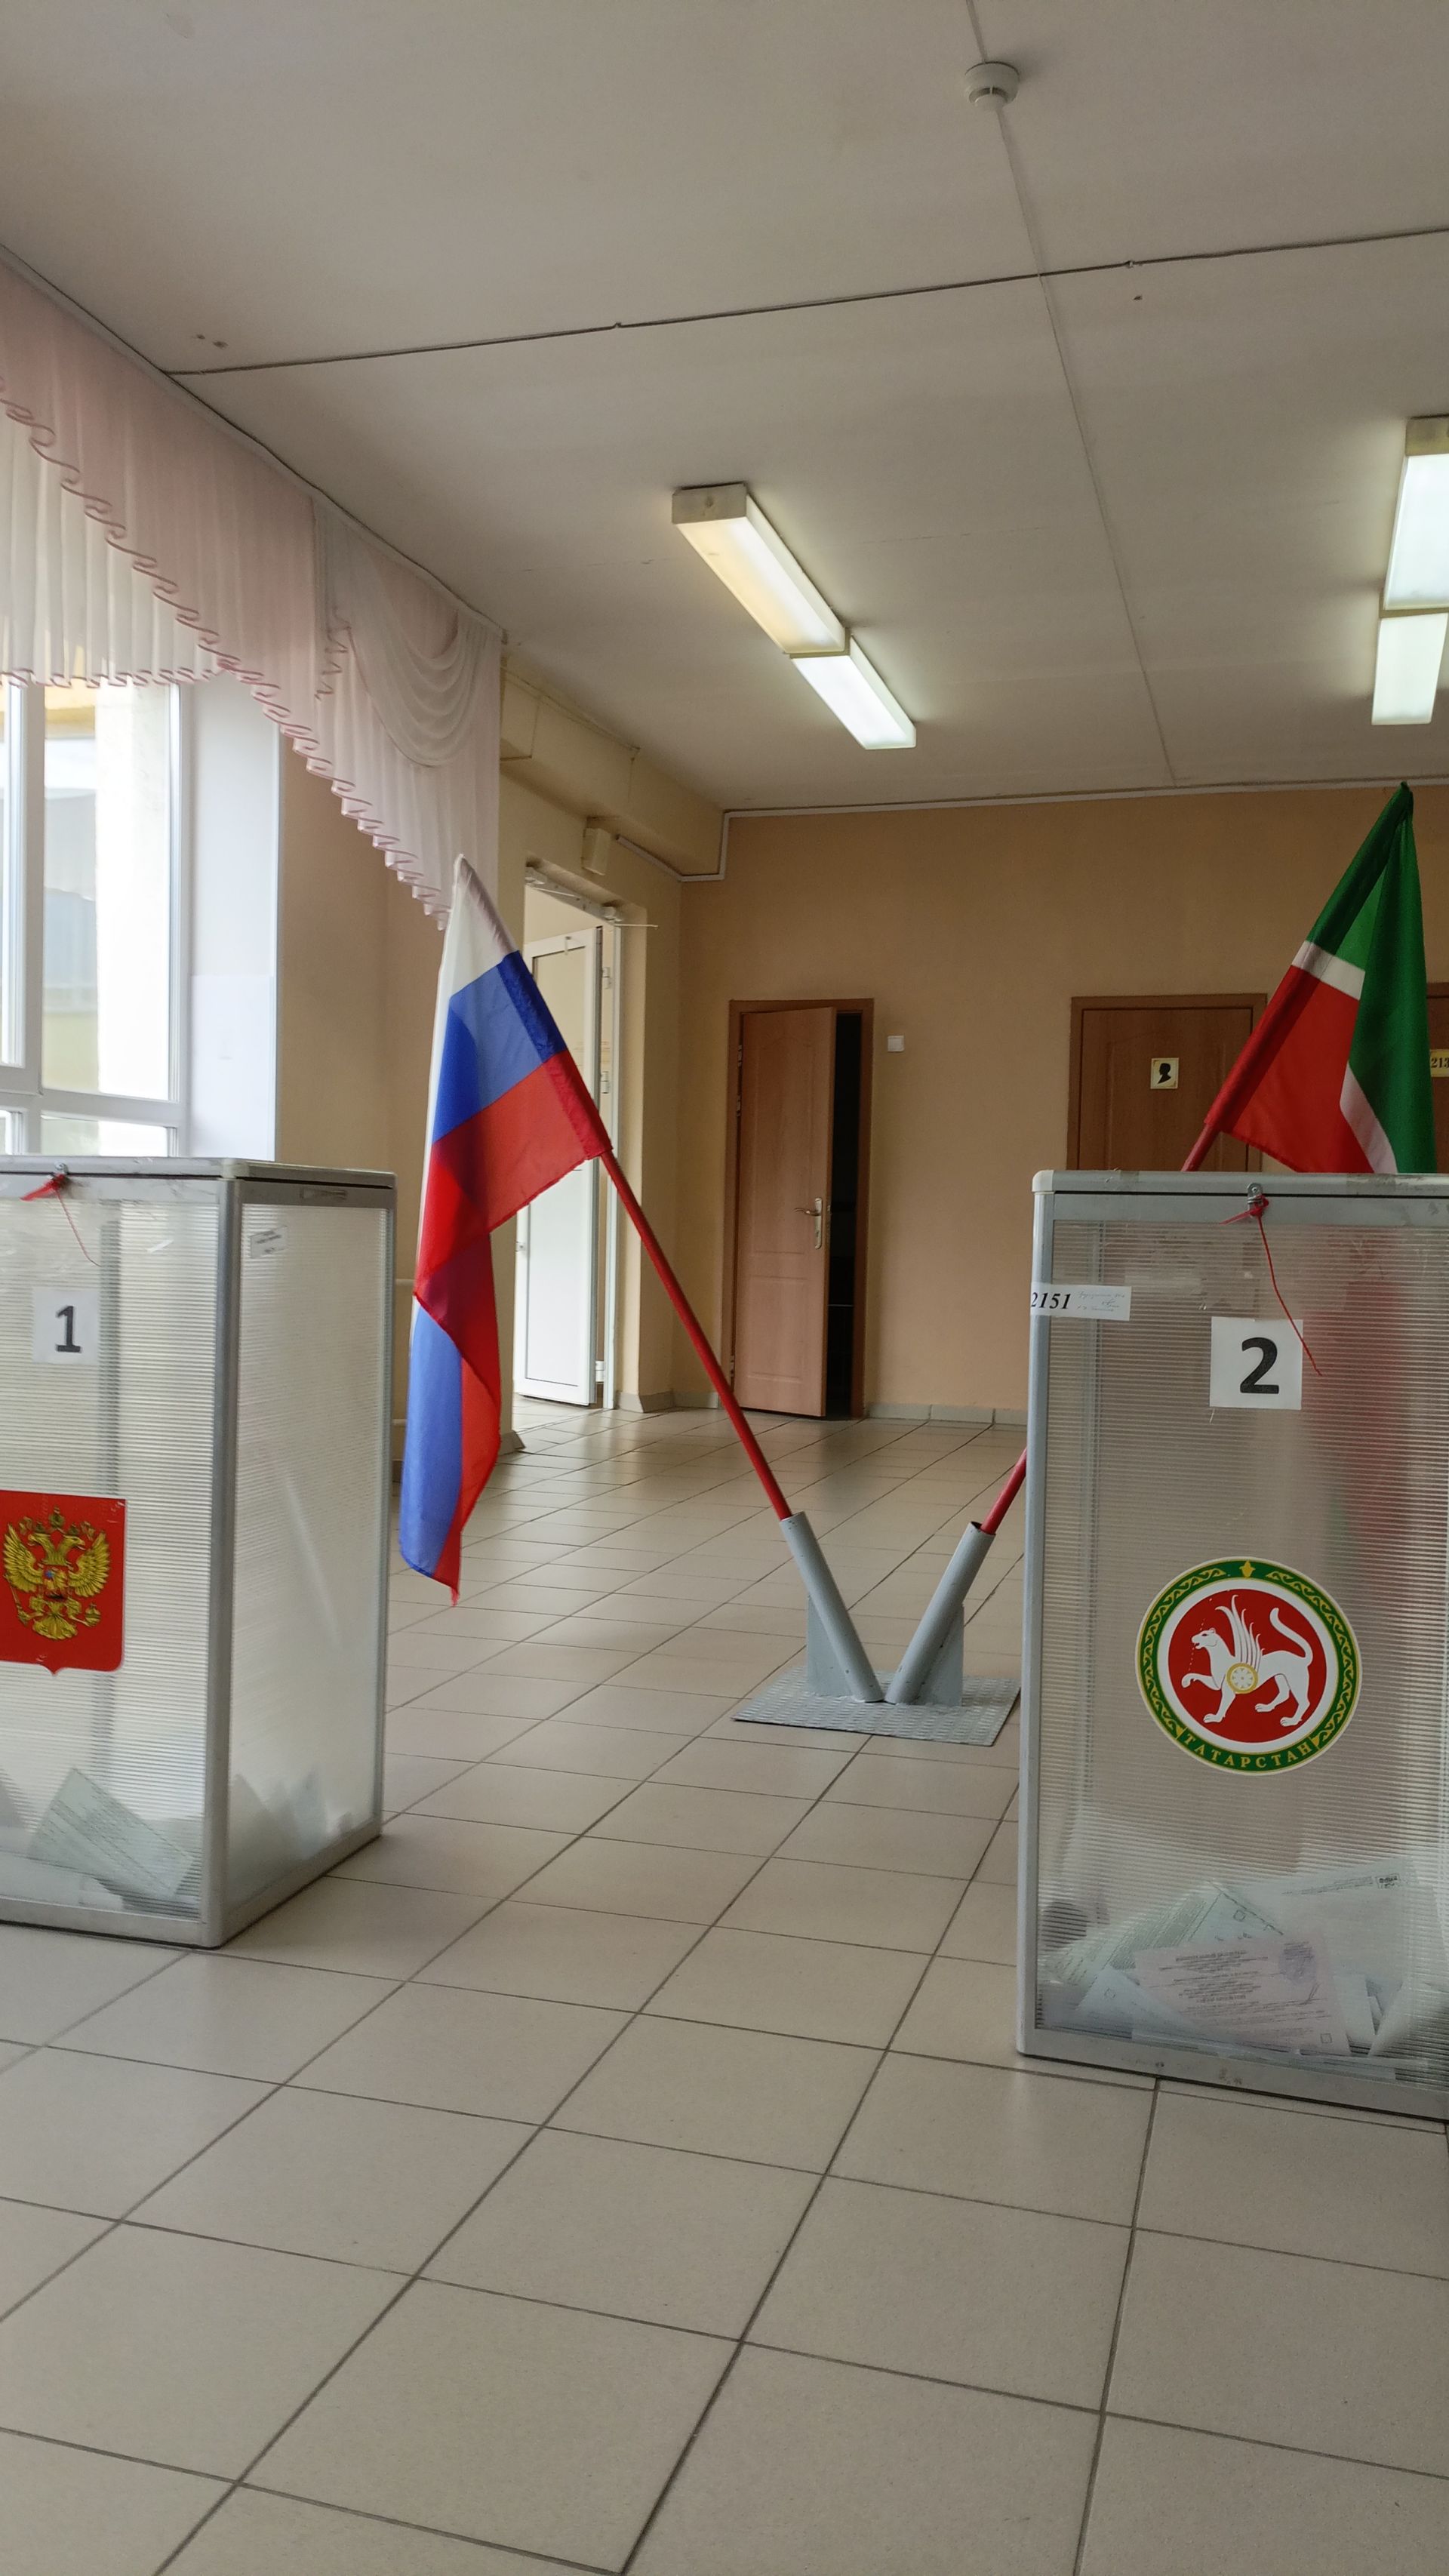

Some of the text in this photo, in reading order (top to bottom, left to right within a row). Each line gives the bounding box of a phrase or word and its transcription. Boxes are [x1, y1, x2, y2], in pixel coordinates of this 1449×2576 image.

[1031, 1292, 1071, 1310] 2151
[56, 1305, 82, 1353] 1
[1239, 1337, 1280, 1394] 2
[1185, 1734, 1313, 1768] ТАТАРСТАН
